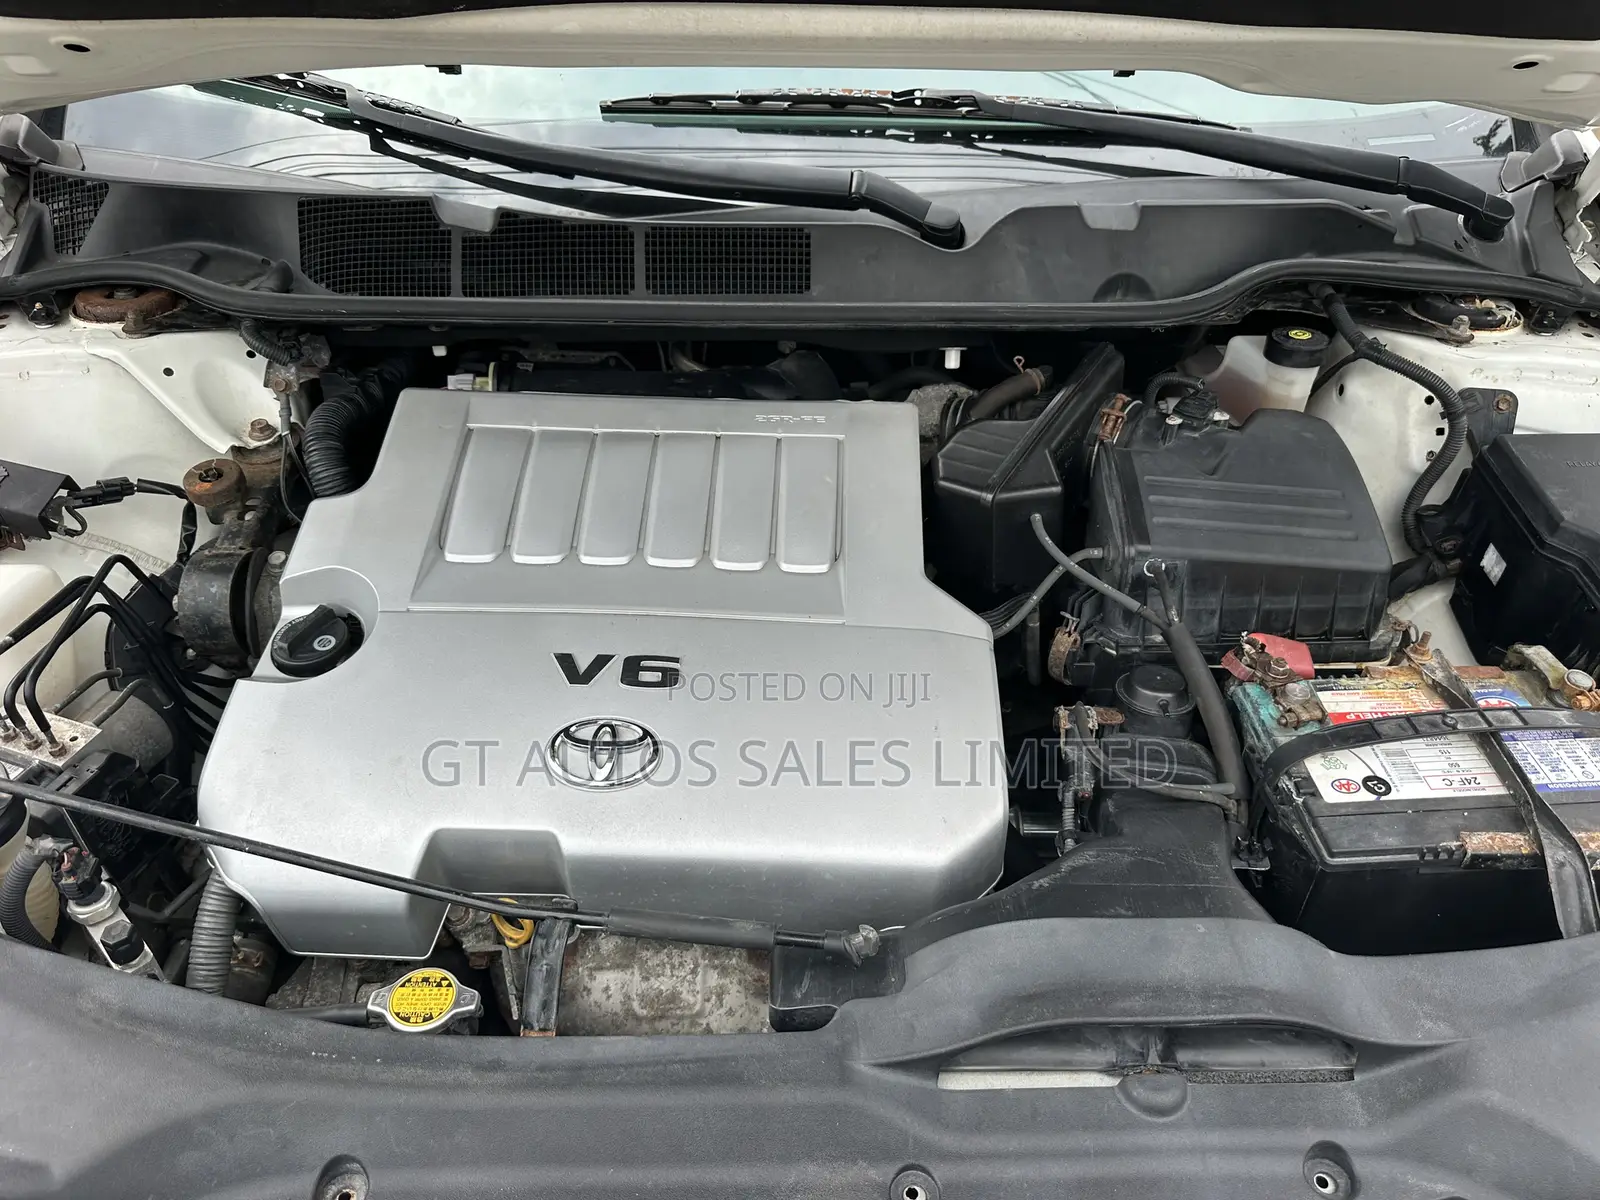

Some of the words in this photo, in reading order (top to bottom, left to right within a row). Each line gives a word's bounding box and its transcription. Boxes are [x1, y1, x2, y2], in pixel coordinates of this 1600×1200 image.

[551, 652, 682, 690] V6
[1334, 780, 1358, 793] CAA
[1366, 780, 1386, 793] C7
[1442, 776, 1481, 787] 24F-C
